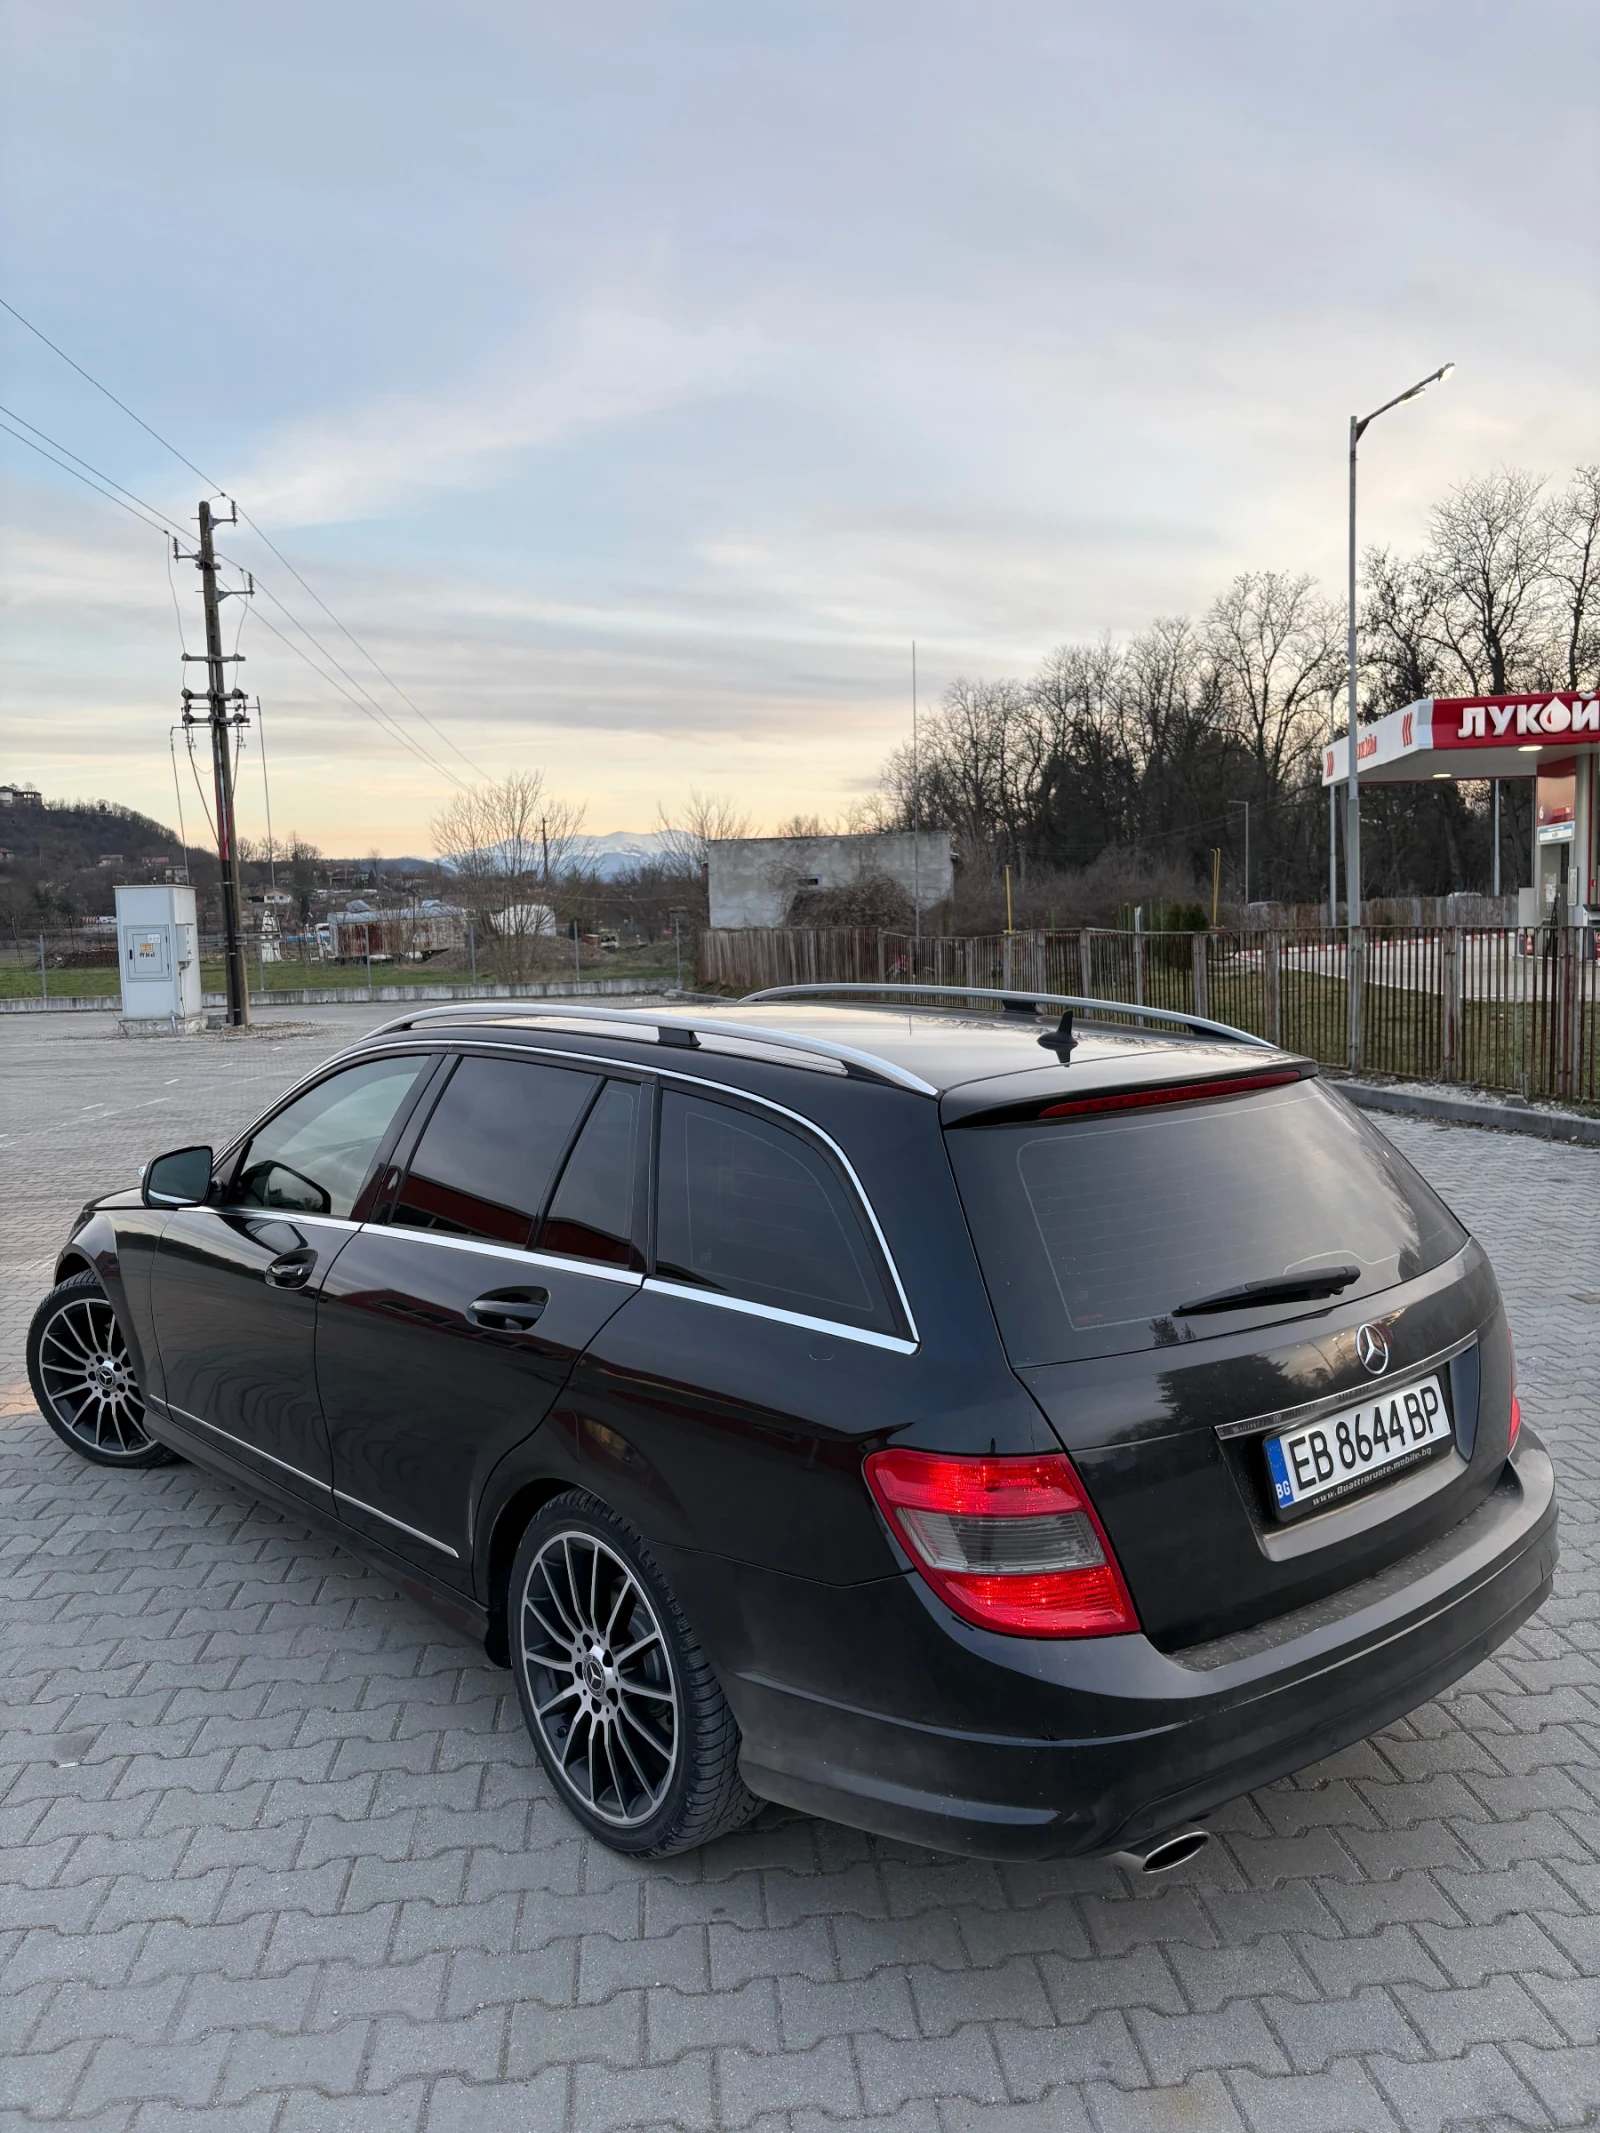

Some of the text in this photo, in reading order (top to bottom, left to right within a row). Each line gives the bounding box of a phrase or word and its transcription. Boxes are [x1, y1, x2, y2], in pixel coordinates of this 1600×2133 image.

[1288, 1386, 1439, 1491] EB 8644 BP
[1275, 1481, 1291, 1499] BG
